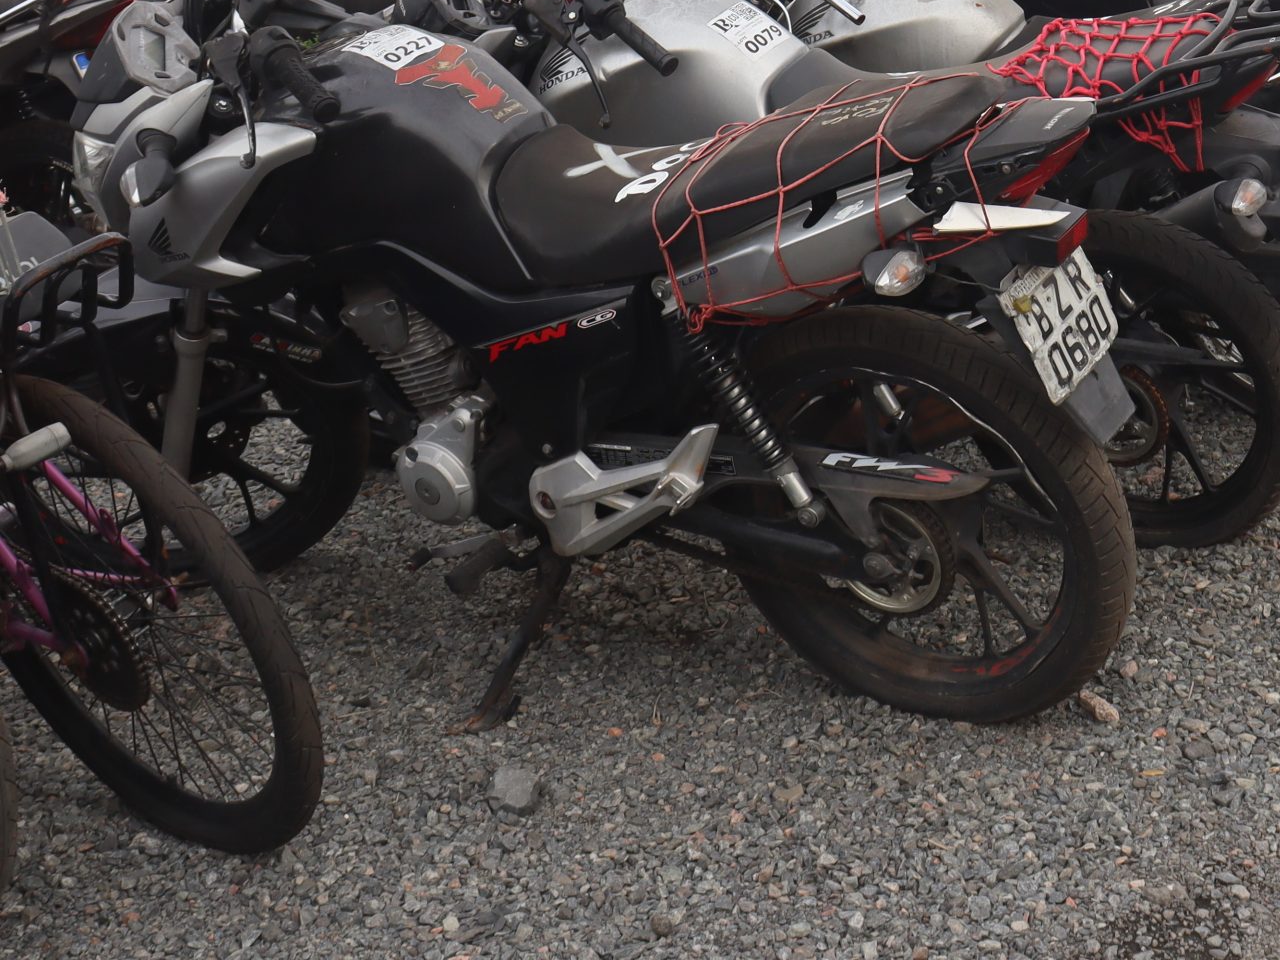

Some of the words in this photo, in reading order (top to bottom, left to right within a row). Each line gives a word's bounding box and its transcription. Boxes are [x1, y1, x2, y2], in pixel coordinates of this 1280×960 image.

[383, 36, 433, 63] 0227
[744, 25, 783, 53] 0079
[539, 66, 589, 96] HONDA
[158, 252, 191, 264] HONDA
[1028, 256, 1091, 341] BZR
[488, 322, 569, 363] FAN
[1048, 294, 1111, 389] 0680
